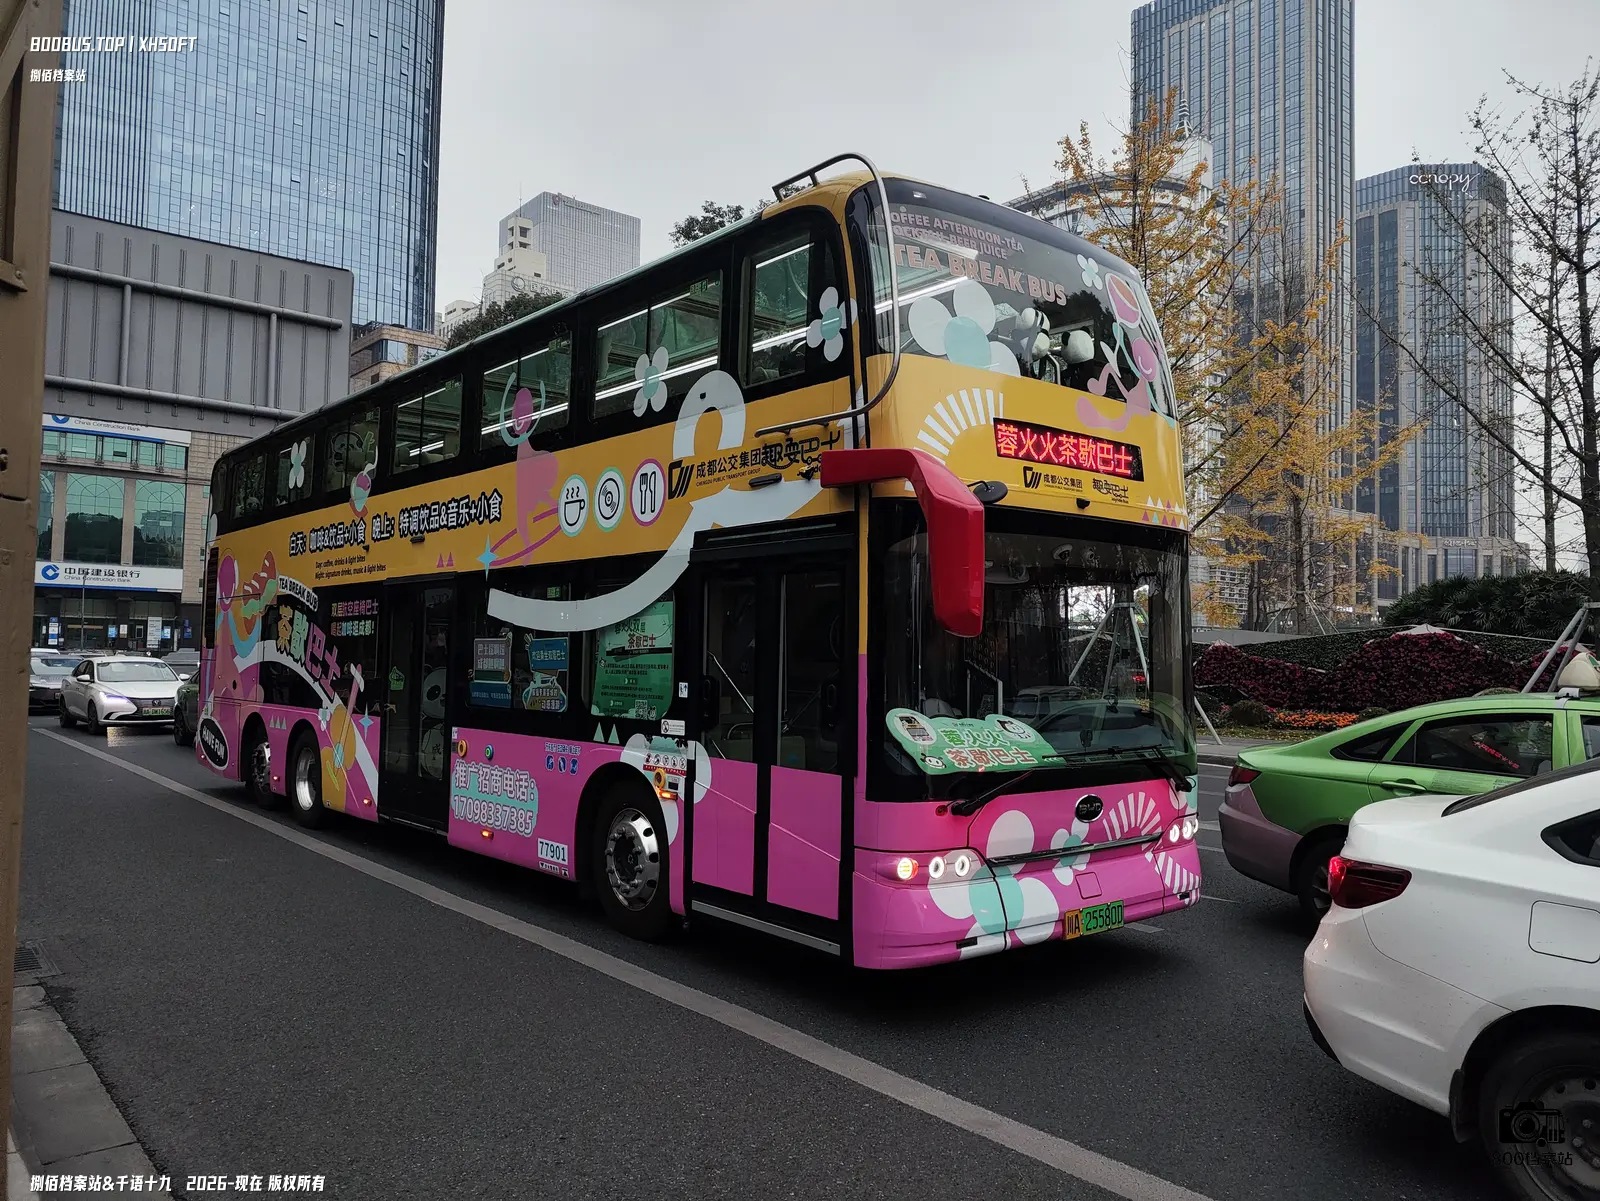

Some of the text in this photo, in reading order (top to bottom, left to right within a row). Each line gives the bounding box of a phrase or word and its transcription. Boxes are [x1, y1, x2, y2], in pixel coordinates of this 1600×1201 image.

[1409, 172, 1481, 192] canopy
[889, 211, 931, 228] OFFEE
[979, 240, 1008, 260] JUICE
[893, 243, 1067, 306] TEA BREAK BUS
[92, 421, 126, 430] Construction
[996, 423, 1133, 475] 蓉火火茶歇巴士
[696, 448, 761, 479] 成都公交集团
[725, 472, 748, 481] TRANSPORT
[64, 567, 141, 579] 中国建设银行
[280, 577, 319, 612] TEA BREAK BUS
[202, 725, 225, 760] HAVE FUN
[939, 728, 1010, 747] 蓉火火
[944, 746, 1038, 769] 茶歇巴士
[453, 795, 534, 835] 17098337385
[1079, 802, 1102, 815] BYD
[539, 840, 566, 862] 77901
